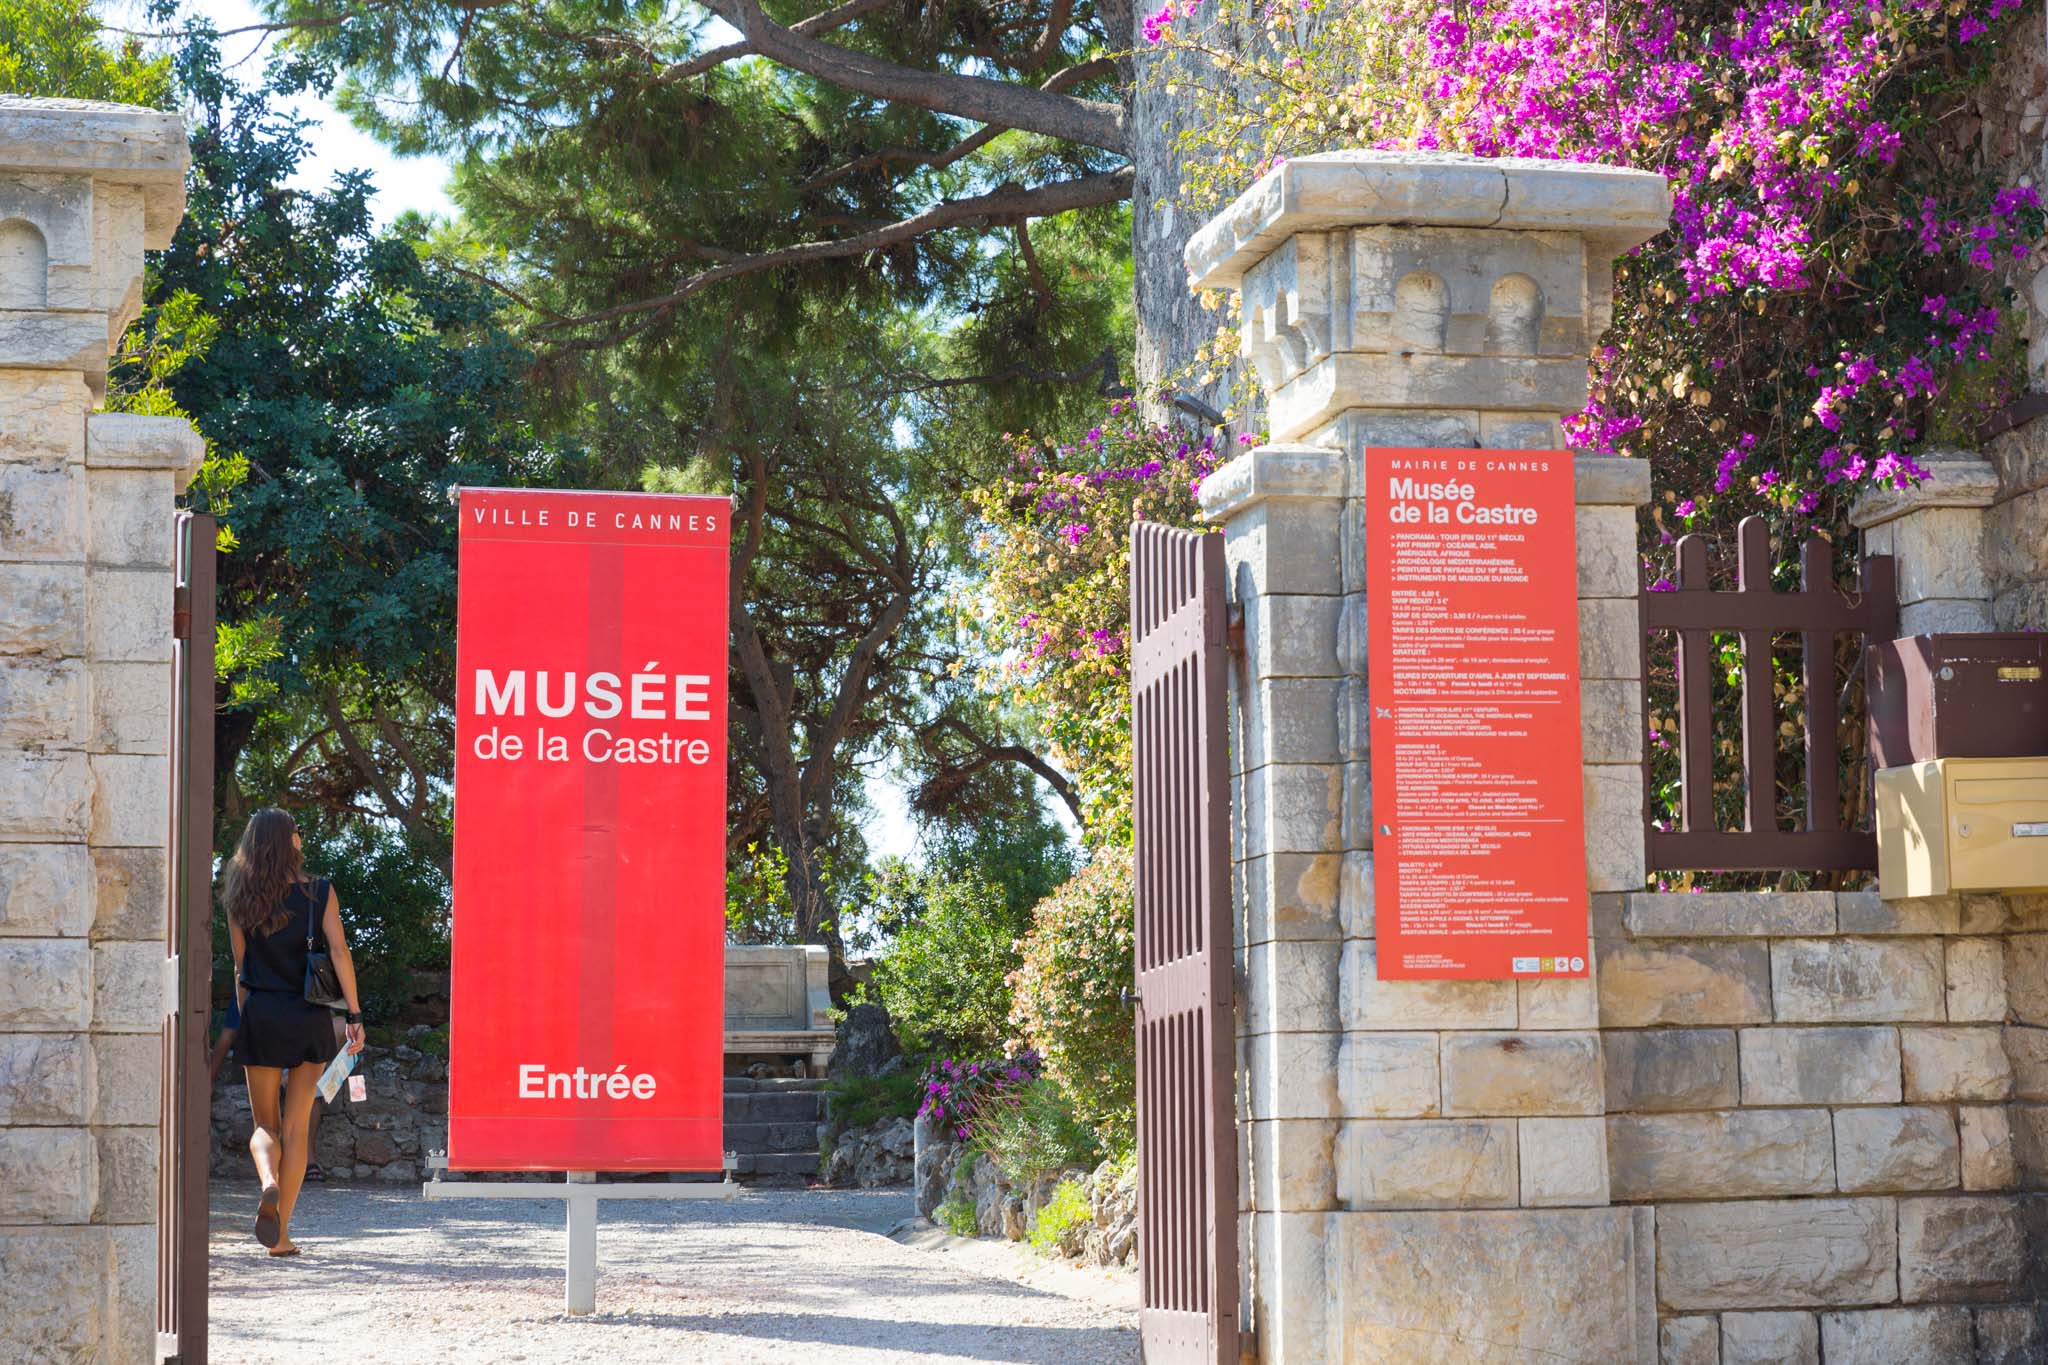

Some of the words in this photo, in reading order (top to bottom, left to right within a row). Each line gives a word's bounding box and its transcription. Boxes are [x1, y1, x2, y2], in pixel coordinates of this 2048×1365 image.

[1391, 460, 1447, 470] MAIRIE
[1458, 460, 1477, 471] DE
[1486, 461, 1550, 472] CANNES
[1389, 477, 1476, 501] Musée
[474, 507, 549, 526] VILLE
[568, 511, 598, 528] DE
[615, 512, 717, 532] CANNES
[1389, 501, 1422, 524] de
[1427, 501, 1450, 524] la
[1455, 501, 1538, 525] Castre
[1396, 533, 1436, 541] PANORAMA
[1396, 574, 1446, 582] INSTRUMENTS
[1458, 574, 1490, 582] MUSIQUE
[475, 661, 711, 721] MUSÉE
[474, 726, 523, 761] de
[537, 727, 570, 762] la
[582, 728, 711, 765] Castre
[519, 1064, 657, 1100] Entrée
